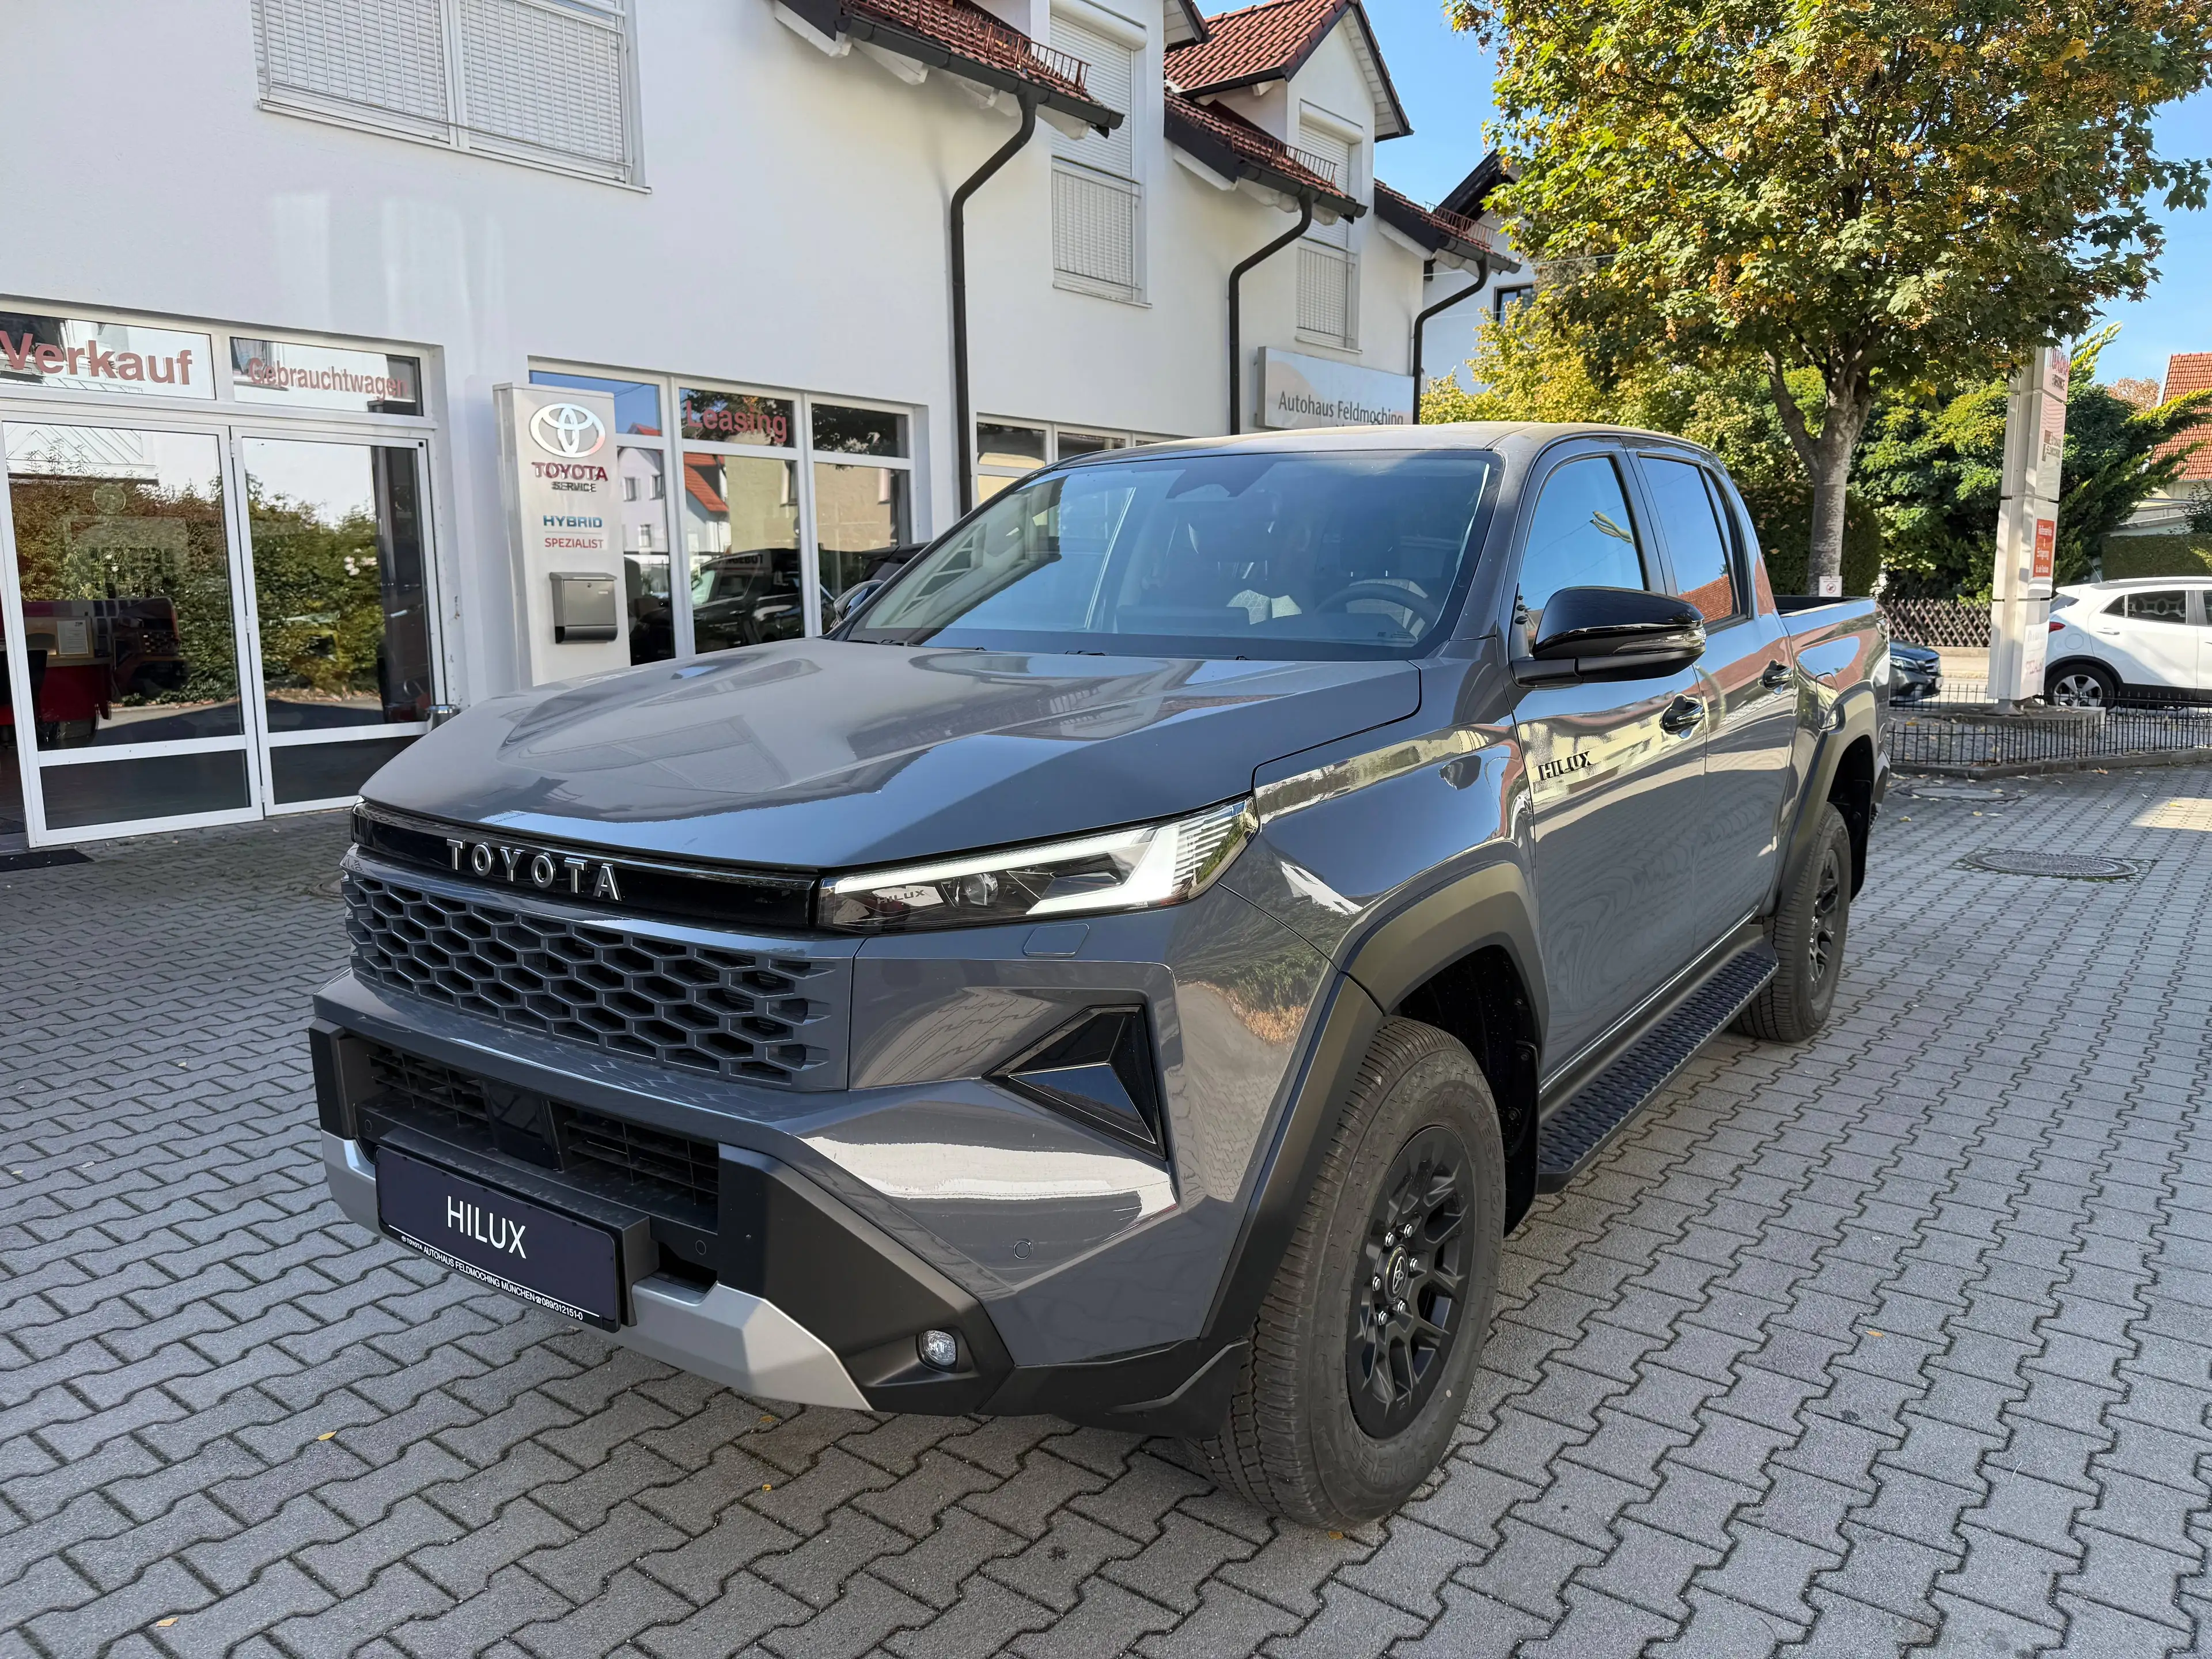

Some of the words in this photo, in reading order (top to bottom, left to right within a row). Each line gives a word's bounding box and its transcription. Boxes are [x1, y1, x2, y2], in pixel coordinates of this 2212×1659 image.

[0, 331, 192, 385] Verkauf
[248, 357, 408, 402] Gebrauchtwagen
[1278, 390, 1334, 418] Autohaus
[686, 400, 787, 443] Leasing
[531, 462, 608, 482] TOYOTA
[551, 481, 597, 493] SERVICE
[543, 515, 603, 528] HYBRID
[544, 537, 604, 549] SPEZIALIST
[1537, 751, 1592, 781] HILUX
[446, 838, 622, 902] TOYOTA
[877, 889, 925, 904] HILUX
[448, 1195, 527, 1259] HILUX
[406, 1237, 423, 1251] TOYOTA
[423, 1246, 454, 1267] AUTOHAUS
[455, 1262, 500, 1287] FELDMOCHING
[501, 1280, 536, 1302] MÜNCHEN
[541, 1298, 584, 1321] 089/312151-0
